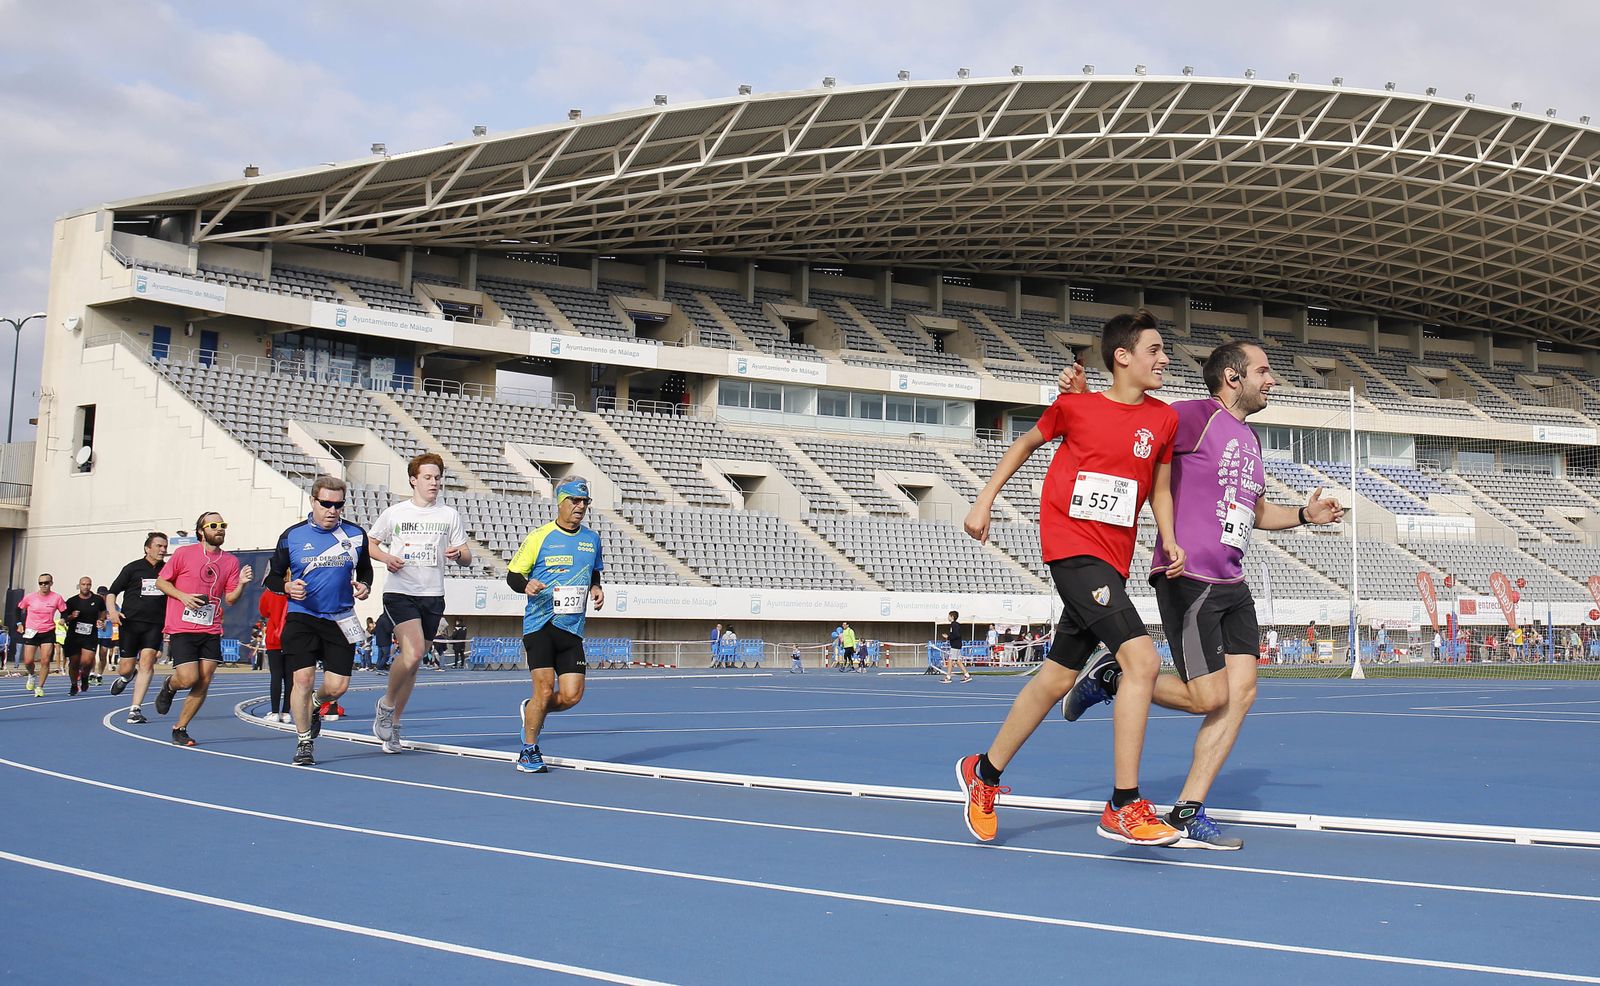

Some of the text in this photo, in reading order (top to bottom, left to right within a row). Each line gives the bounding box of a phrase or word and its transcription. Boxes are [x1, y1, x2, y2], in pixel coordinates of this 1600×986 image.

[352, 315, 398, 328] Ayuntamiento
[566, 343, 607, 354] Ayuntamiento
[752, 363, 790, 373] Ayuntamiento
[1242, 456, 1255, 475] 24
[1088, 492, 1119, 512] 557
[401, 522, 420, 532] BIKE
[301, 556, 318, 564] CLUB
[564, 596, 580, 607] 237
[633, 596, 680, 607] Ayuntamiento
[682, 596, 691, 605] de
[767, 600, 812, 609] Ayuntamiento
[814, 600, 823, 608] de
[192, 609, 207, 619] 359
